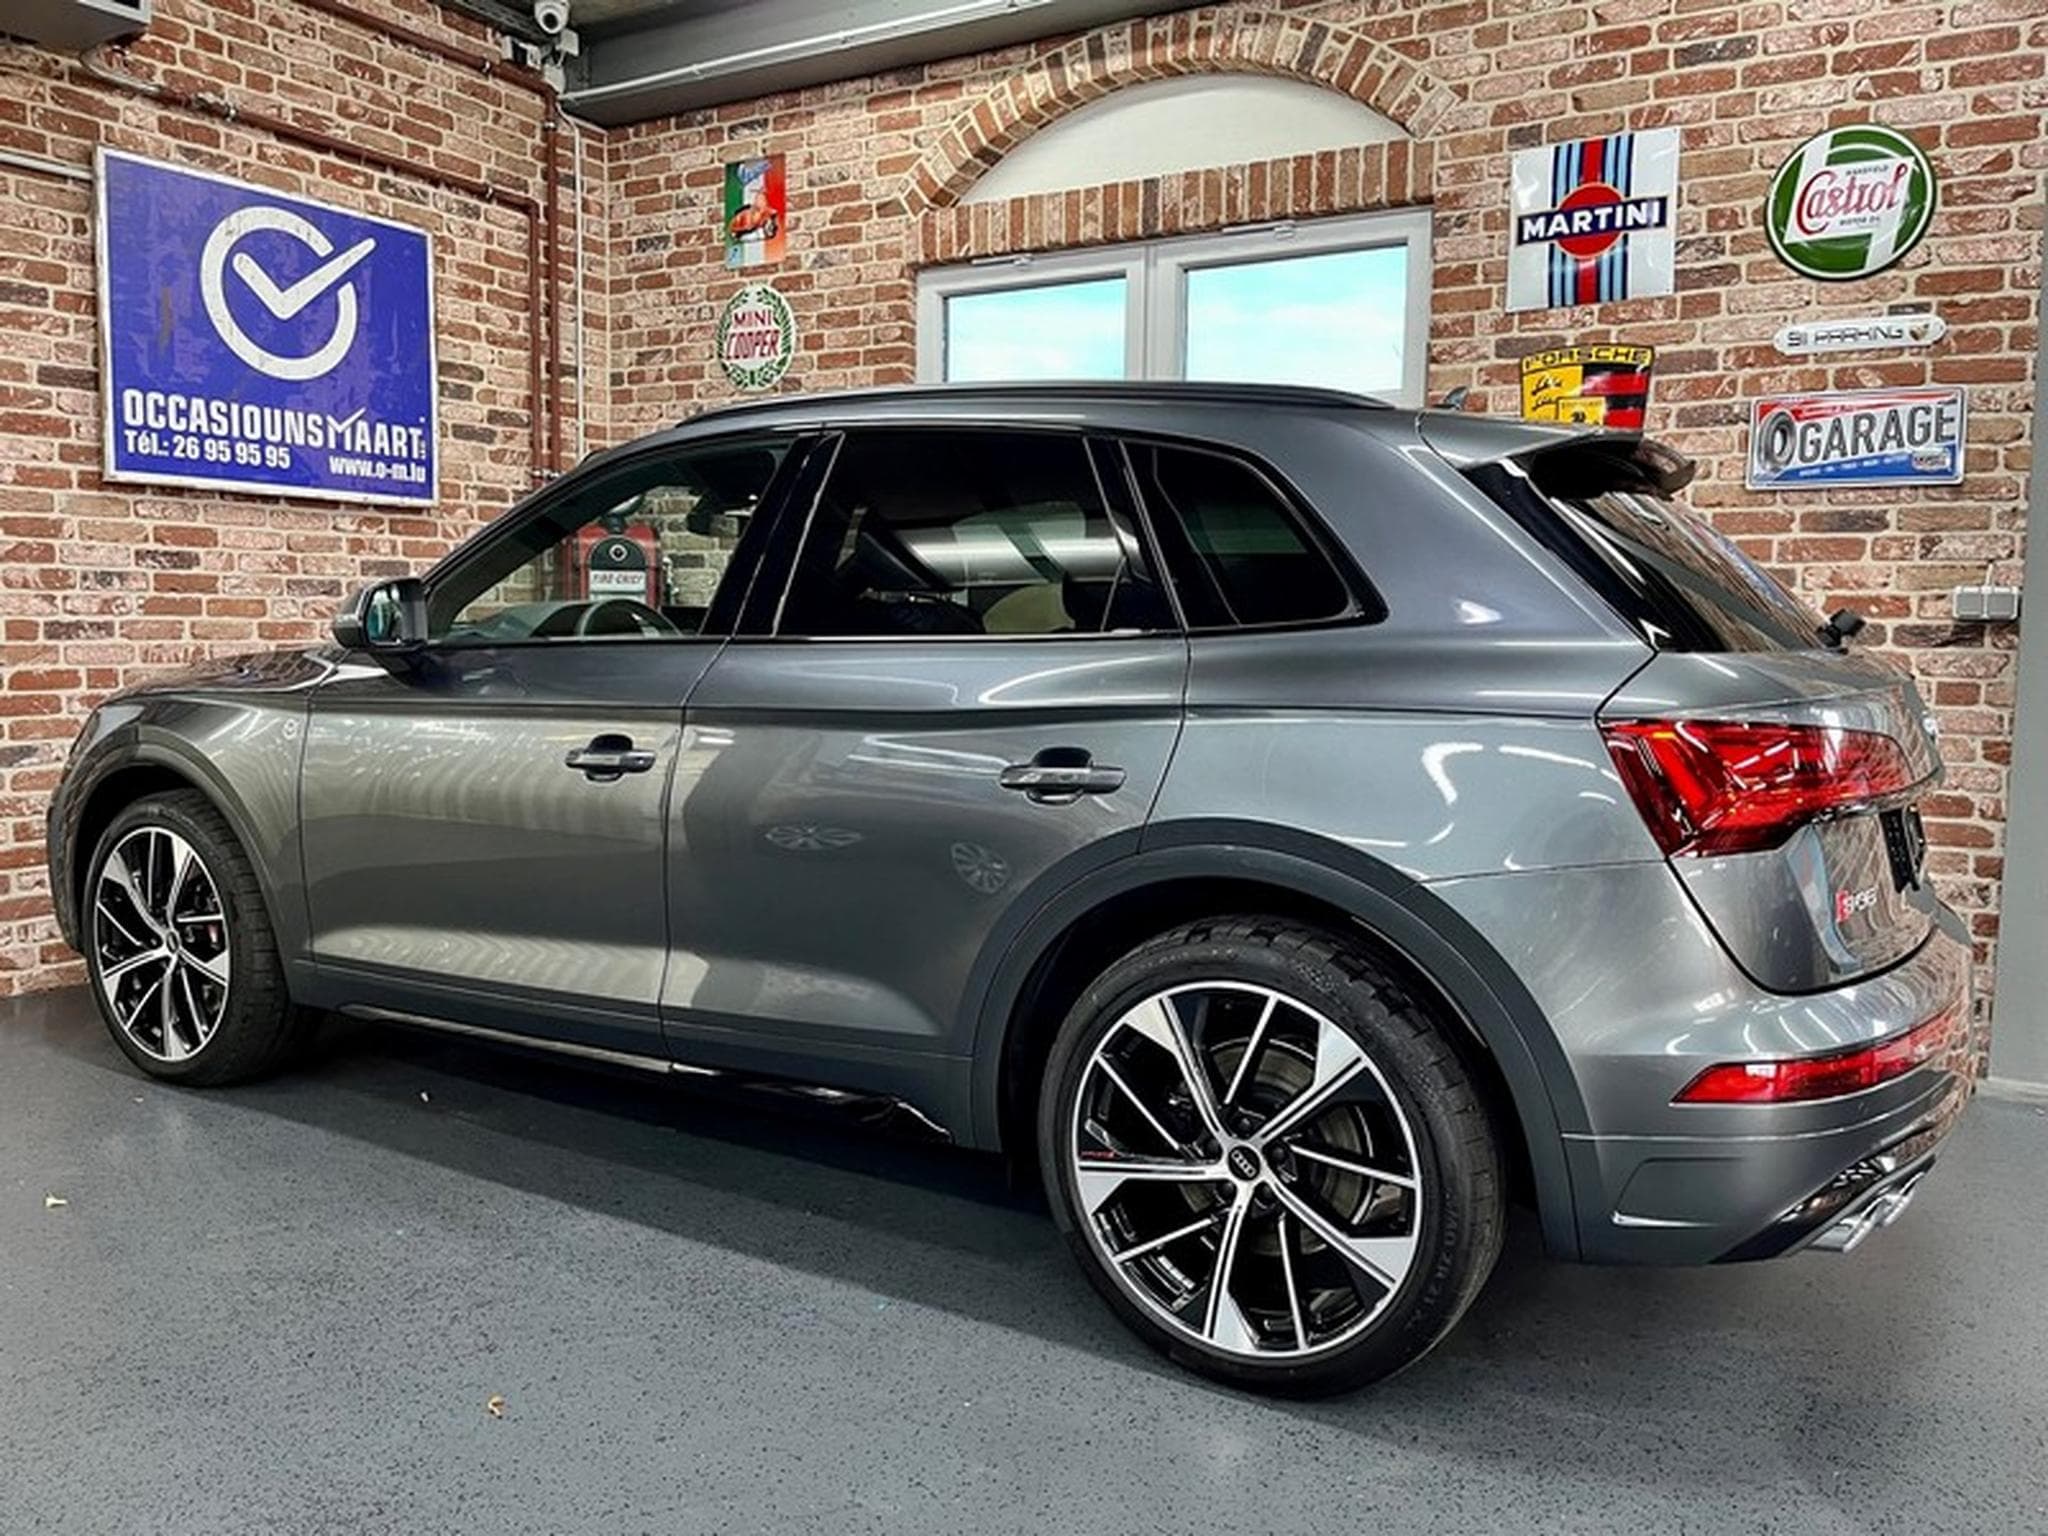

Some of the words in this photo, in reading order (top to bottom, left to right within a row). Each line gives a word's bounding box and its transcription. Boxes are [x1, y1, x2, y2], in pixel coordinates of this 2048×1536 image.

[1796, 163, 1908, 235] Castrol
[1522, 201, 1660, 241] MARTINI
[733, 309, 772, 328] MINI
[726, 330, 780, 360] COOPER
[1815, 325, 1903, 346] PARKING
[1525, 347, 1649, 369] PORSCHE
[1799, 400, 1958, 464] GARAGE
[173, 434, 200, 460] 26
[204, 438, 231, 463] 95
[235, 442, 262, 467] 95
[265, 445, 291, 469] 95
[329, 455, 426, 483] www.o-m.lu
